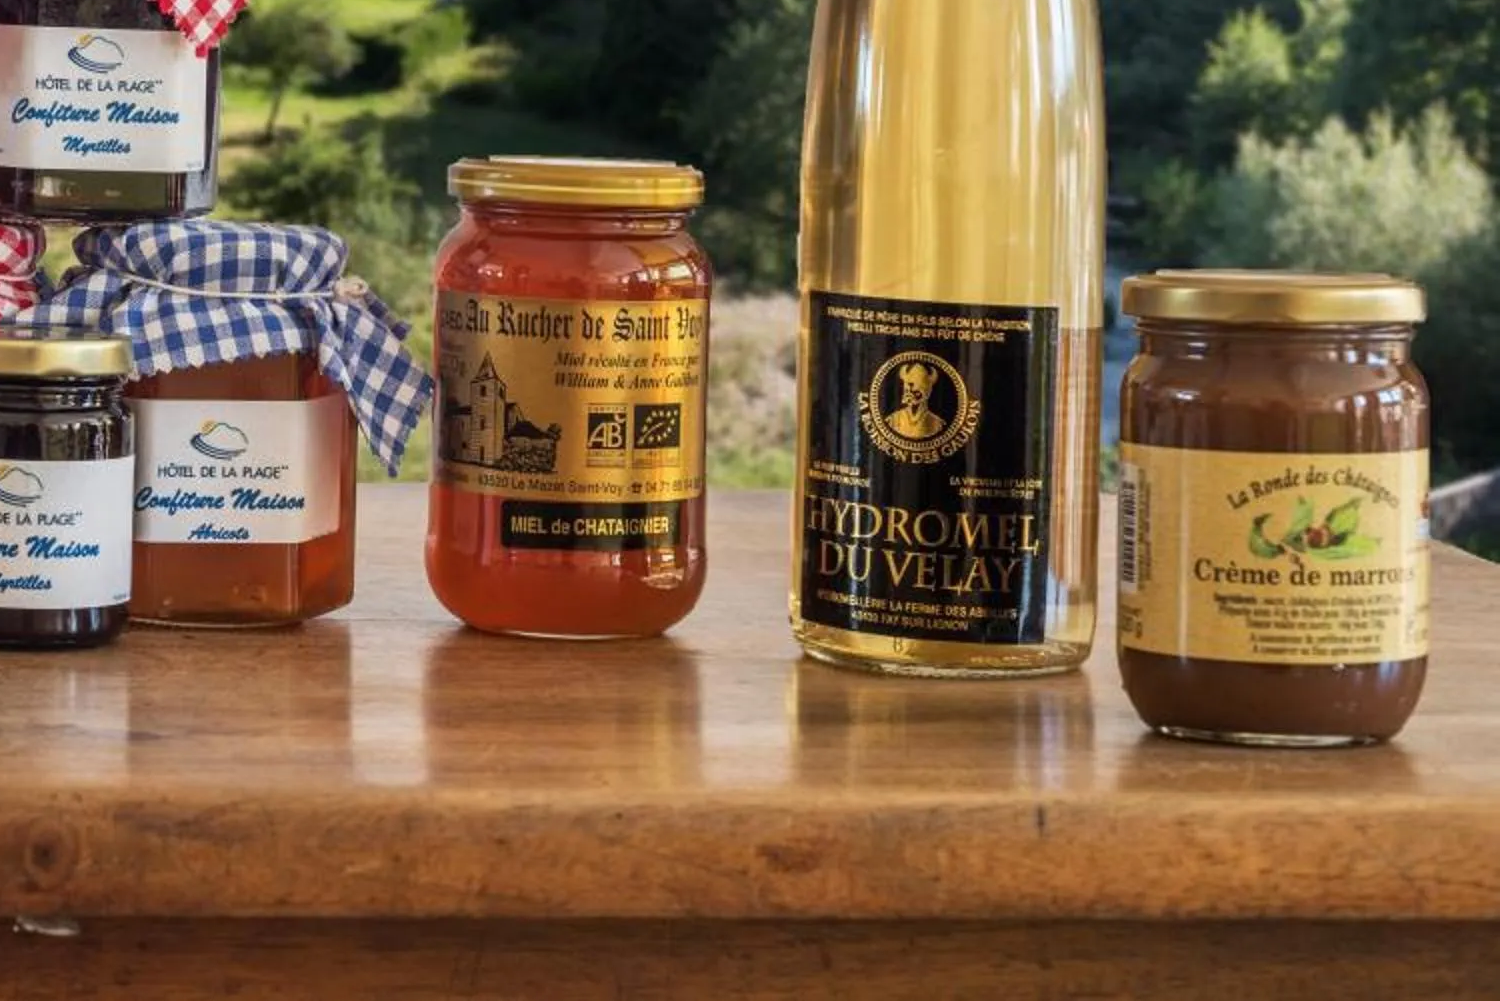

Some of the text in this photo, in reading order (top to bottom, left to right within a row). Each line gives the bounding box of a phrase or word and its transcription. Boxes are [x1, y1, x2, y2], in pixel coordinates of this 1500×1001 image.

[77, 79, 93, 92] DE
[97, 79, 113, 92] LA
[11, 97, 180, 127] Confiture Maison
[62, 136, 131, 157] Myrtilles
[466, 299, 490, 334] Au
[497, 300, 574, 344] Rucher
[582, 307, 605, 340] de
[612, 307, 671, 341] Saint
[554, 371, 609, 389] William
[613, 374, 626, 390] &
[587, 422, 623, 449] AB
[201, 466, 217, 478] DE
[222, 466, 238, 478] LA
[1227, 487, 1249, 510] La
[1250, 467, 1300, 499] Ronde
[1305, 464, 1328, 486] des
[134, 486, 305, 516] Confiture Maison
[16, 513, 31, 525] LA
[188, 522, 250, 540] Abricots
[511, 515, 669, 536] MIEL de CHATAIGNIER
[807, 495, 1041, 557] HYDROMEL
[25, 535, 99, 560] Maison
[820, 539, 1022, 595] DU VELAY
[1193, 557, 1415, 586] Crème de marros
